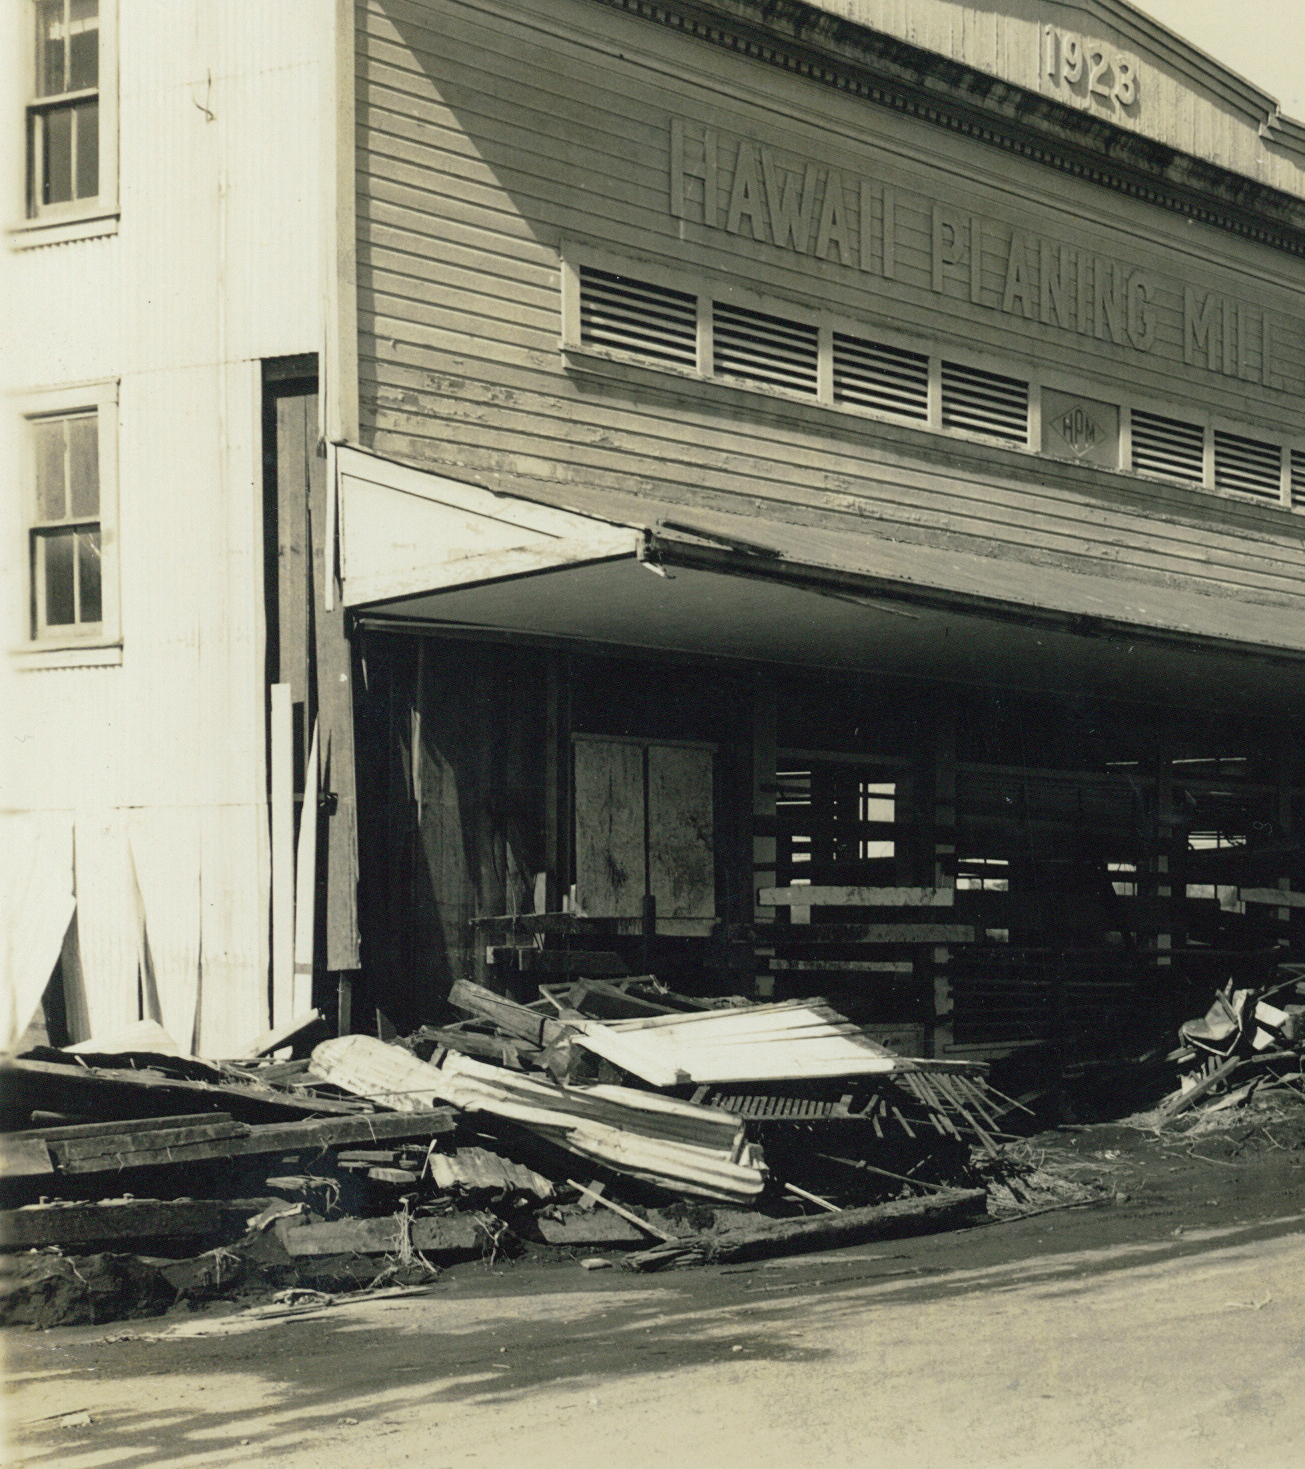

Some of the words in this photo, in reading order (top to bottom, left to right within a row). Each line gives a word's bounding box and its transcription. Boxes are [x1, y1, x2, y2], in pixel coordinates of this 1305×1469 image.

[670, 117, 897, 279] HAWAII
[932, 203, 1156, 354] PLANING
[1183, 284, 1283, 390] MILL
[1063, 408, 1095, 448] HPM
